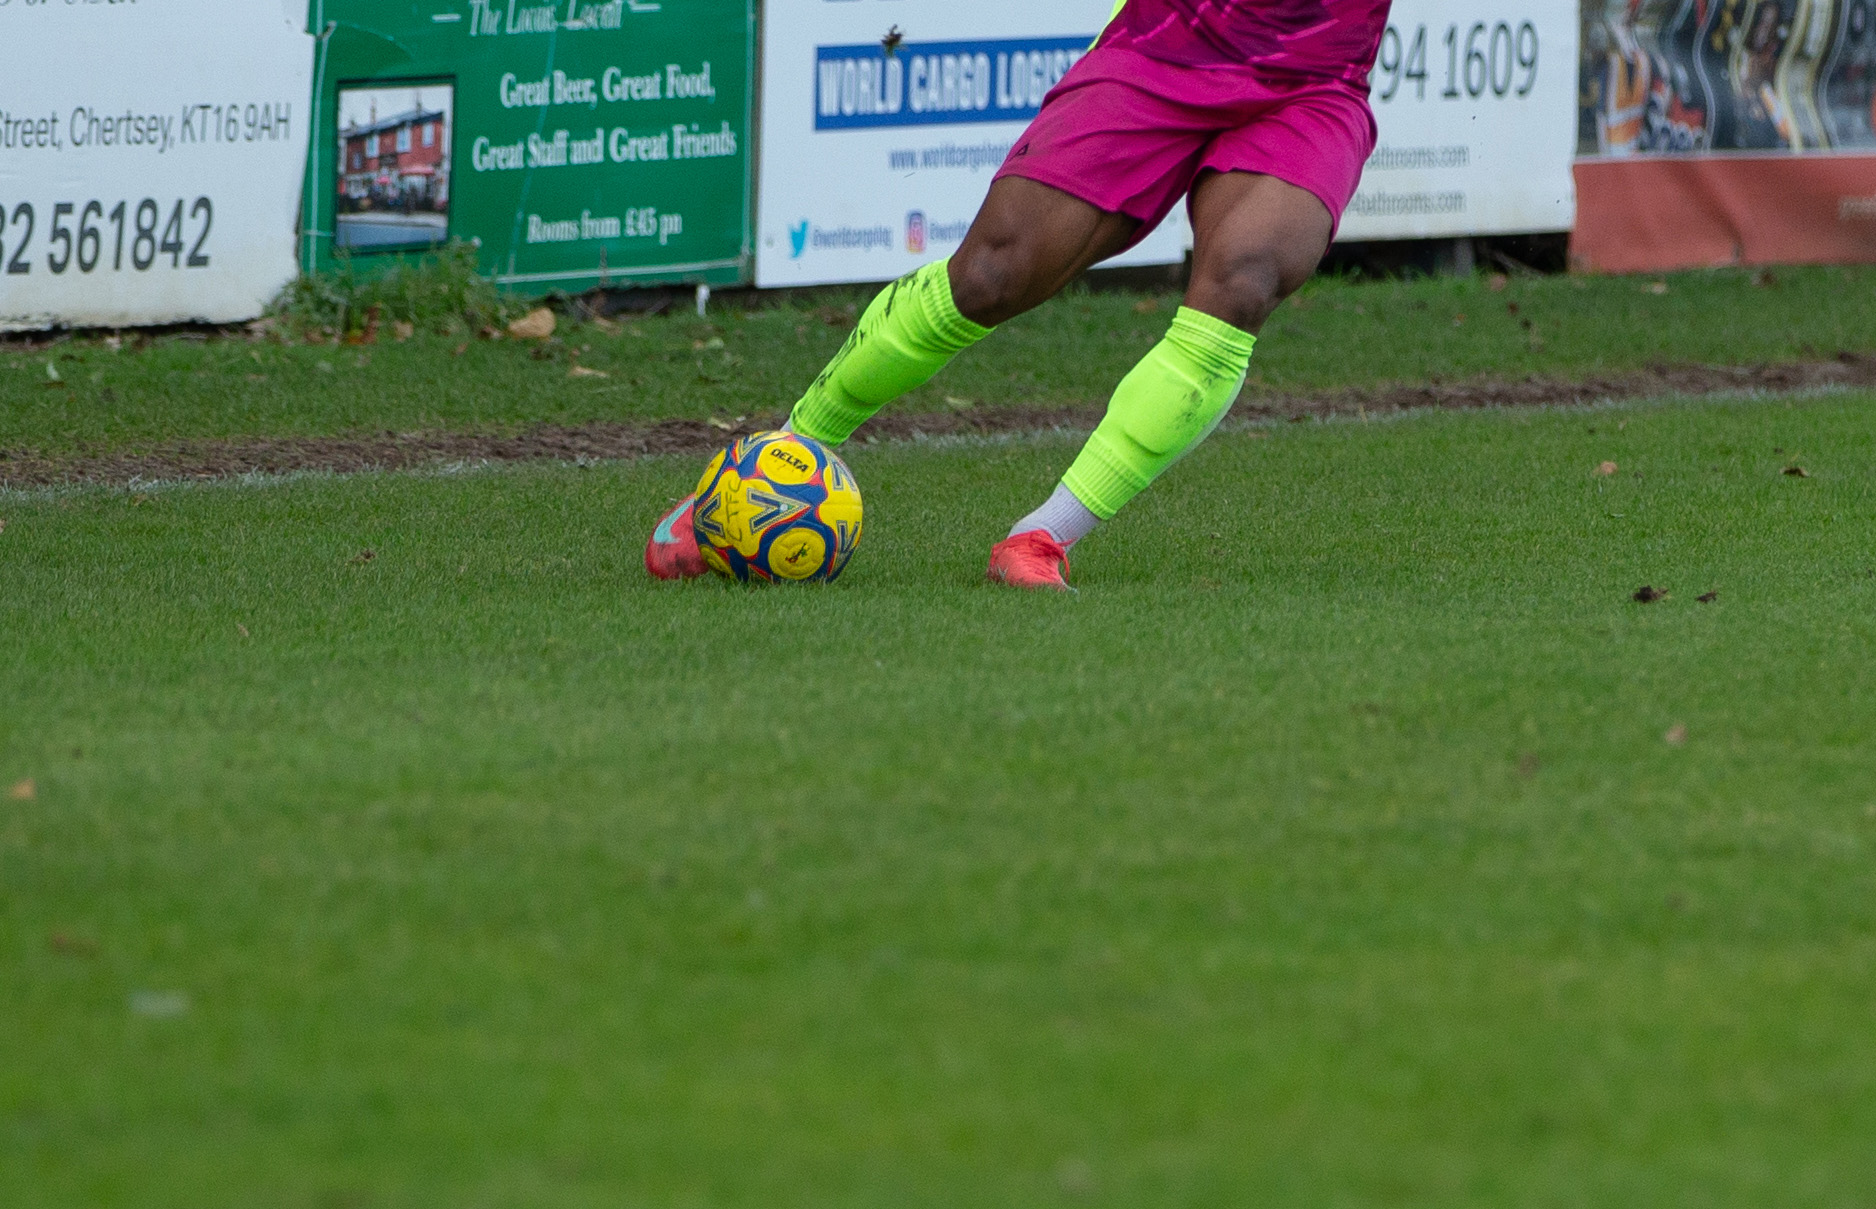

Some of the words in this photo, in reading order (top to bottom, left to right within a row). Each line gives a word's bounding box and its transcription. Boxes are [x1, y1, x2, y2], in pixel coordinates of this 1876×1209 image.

[500, 72, 550, 108] Great
[553, 69, 598, 110] Beer,
[602, 66, 661, 102] Great
[666, 61, 716, 104] Food,
[818, 56, 904, 116] WORLD
[909, 52, 991, 113] CARGO
[1368, 23, 1427, 101] 94
[1441, 18, 1539, 100] 1609
[69, 106, 175, 154] Chertsey,
[180, 104, 240, 143] KT16
[243, 102, 292, 141] 9AH
[472, 136, 524, 171] Great
[528, 129, 569, 168] Staff
[570, 128, 604, 164] and
[609, 127, 669, 162] Great
[672, 120, 737, 160] Friends
[47, 196, 213, 274] 561842
[527, 214, 579, 243] Rooms
[581, 209, 620, 240] from
[769, 448, 810, 473] DELTA
[724, 479, 743, 542] CTFC
